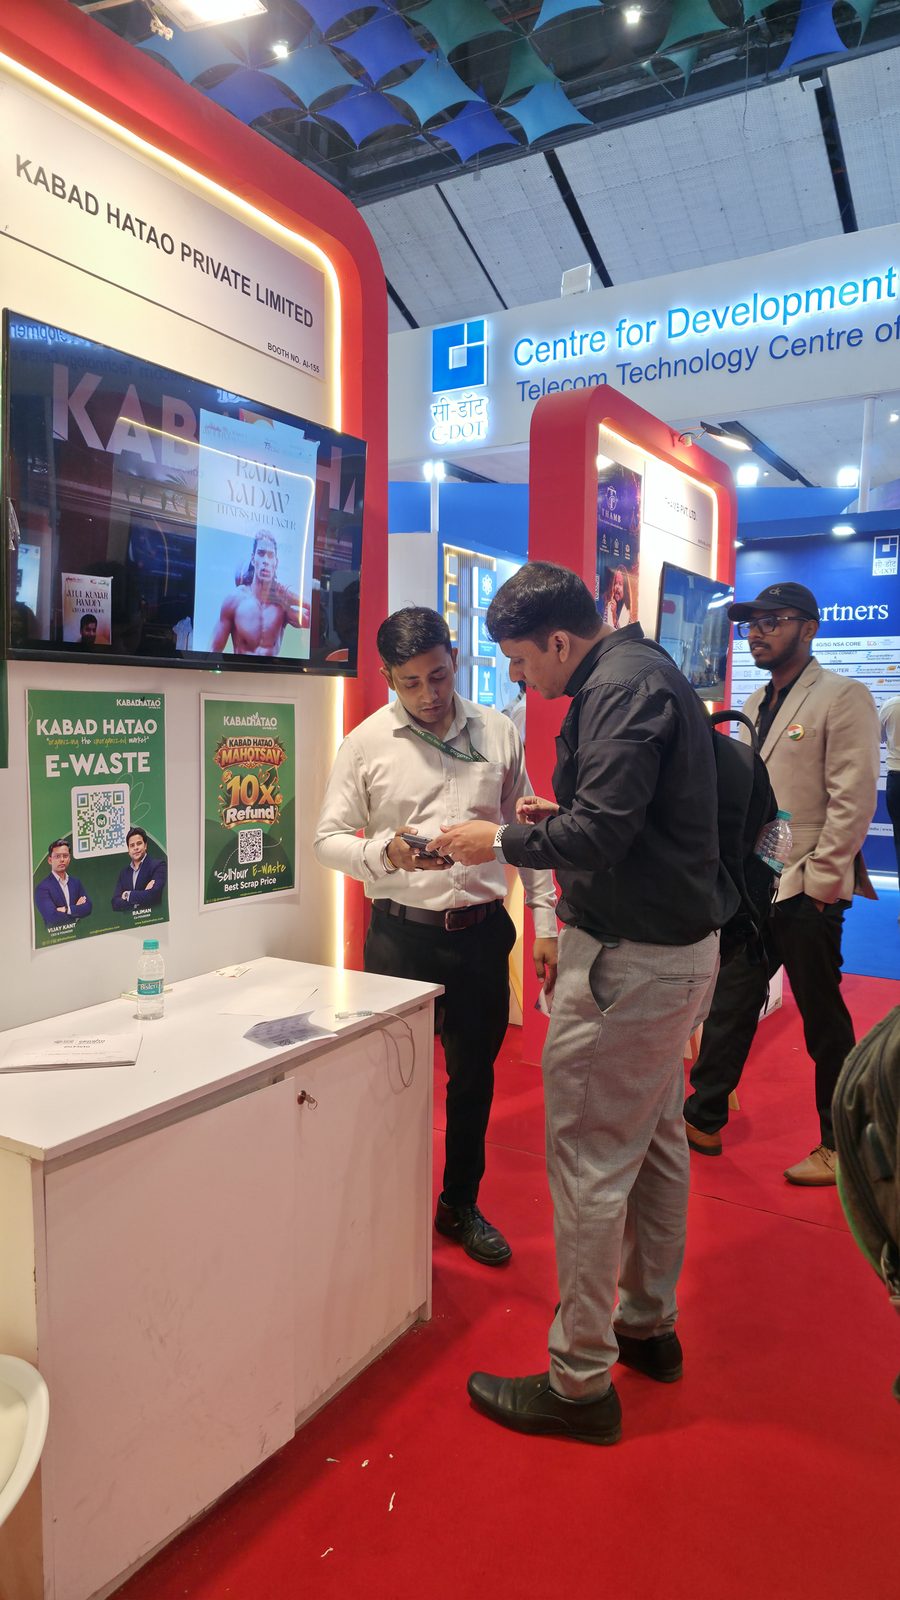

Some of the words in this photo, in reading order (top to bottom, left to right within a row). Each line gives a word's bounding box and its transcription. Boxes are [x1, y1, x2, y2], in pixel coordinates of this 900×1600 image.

[16, 154, 99, 216] KABAD
[106, 203, 175, 255] HATAO
[181, 242, 251, 297] PRIVATE
[256, 283, 314, 328] LIMITED
[513, 330, 606, 367] Centre
[615, 318, 657, 348] for
[667, 266, 897, 340] Development
[267, 342, 289, 359] BOOTH
[290, 354, 302, 365] NO.
[303, 360, 320, 373] AI-155
[516, 373, 607, 402] Telecom
[615, 345, 759, 386] Technology
[769, 327, 864, 360] Centre
[875, 314, 900, 343] of
[432, 394, 485, 422] सी-डॉट
[431, 421, 484, 441] C-DOT
[36, 719, 98, 735] KABAD
[103, 719, 158, 735] HATAO
[81, 737, 92, 745] the
[228, 738, 252, 747] KABAD
[253, 738, 273, 747] HATAO
[46, 751, 151, 778] E-WASTE
[221, 747, 281, 764] MAHOTSAV
[226, 805, 275, 823] Refund
[224, 883, 239, 892] Best
[240, 880, 259, 889] Scrap
[260, 877, 277, 886] Price
[47, 925, 63, 933] VIJAY
[62, 922, 76, 931] KANT
